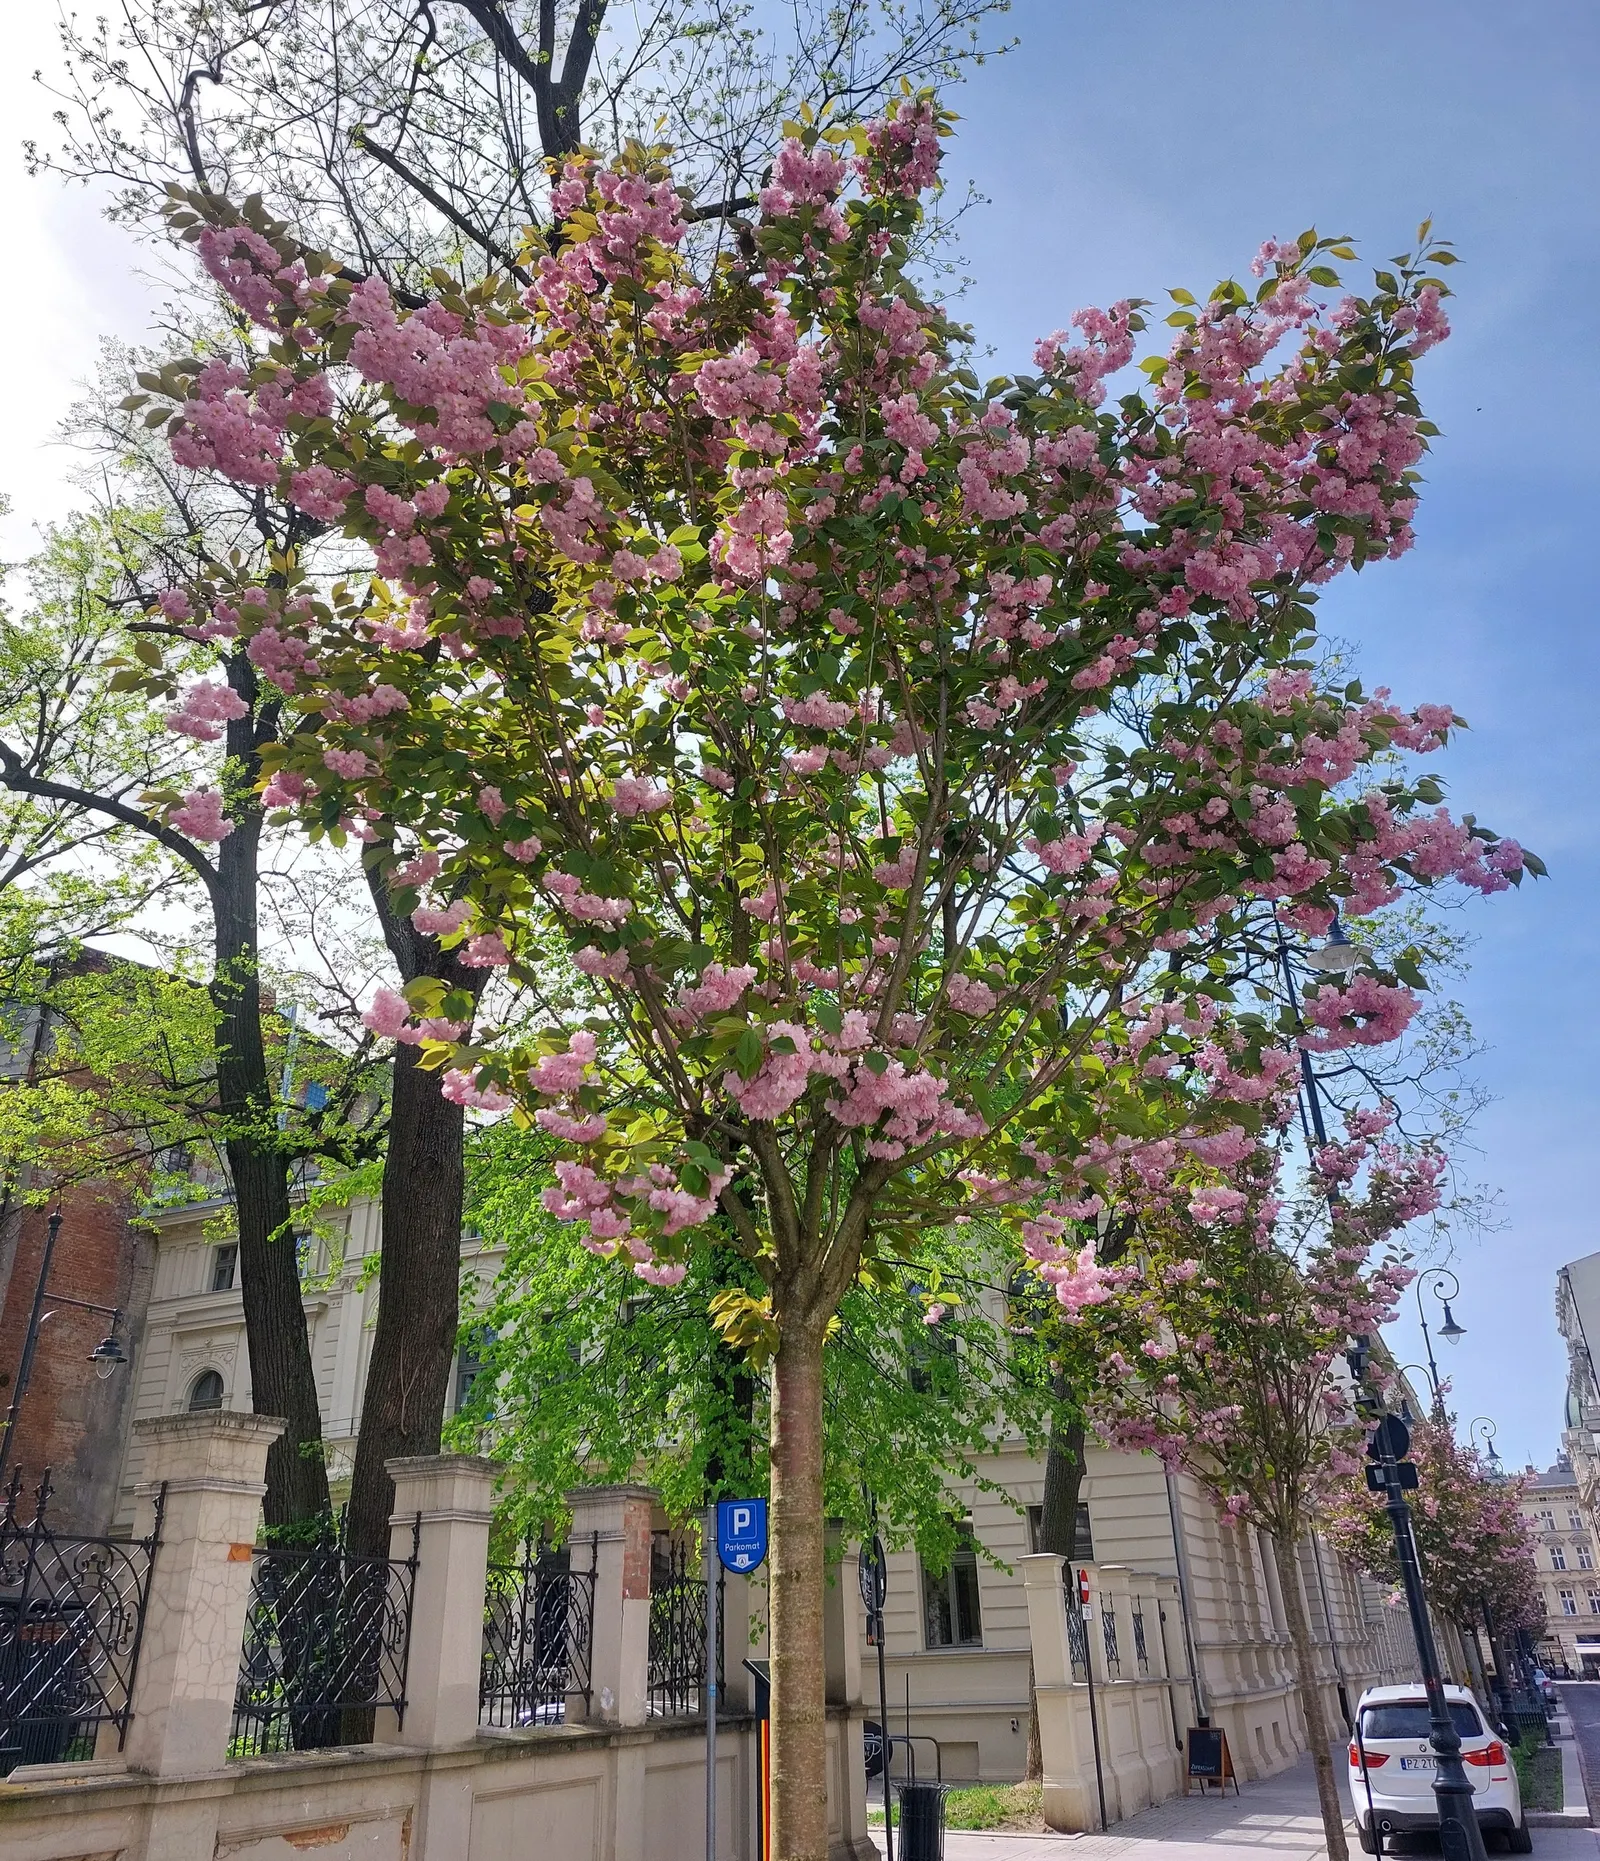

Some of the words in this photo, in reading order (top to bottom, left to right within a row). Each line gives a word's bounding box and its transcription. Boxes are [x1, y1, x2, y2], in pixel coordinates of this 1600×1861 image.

[733, 1508, 751, 1536] P
[724, 1542, 760, 1552] Parkomat
[1406, 1759, 1419, 1769] PZ
